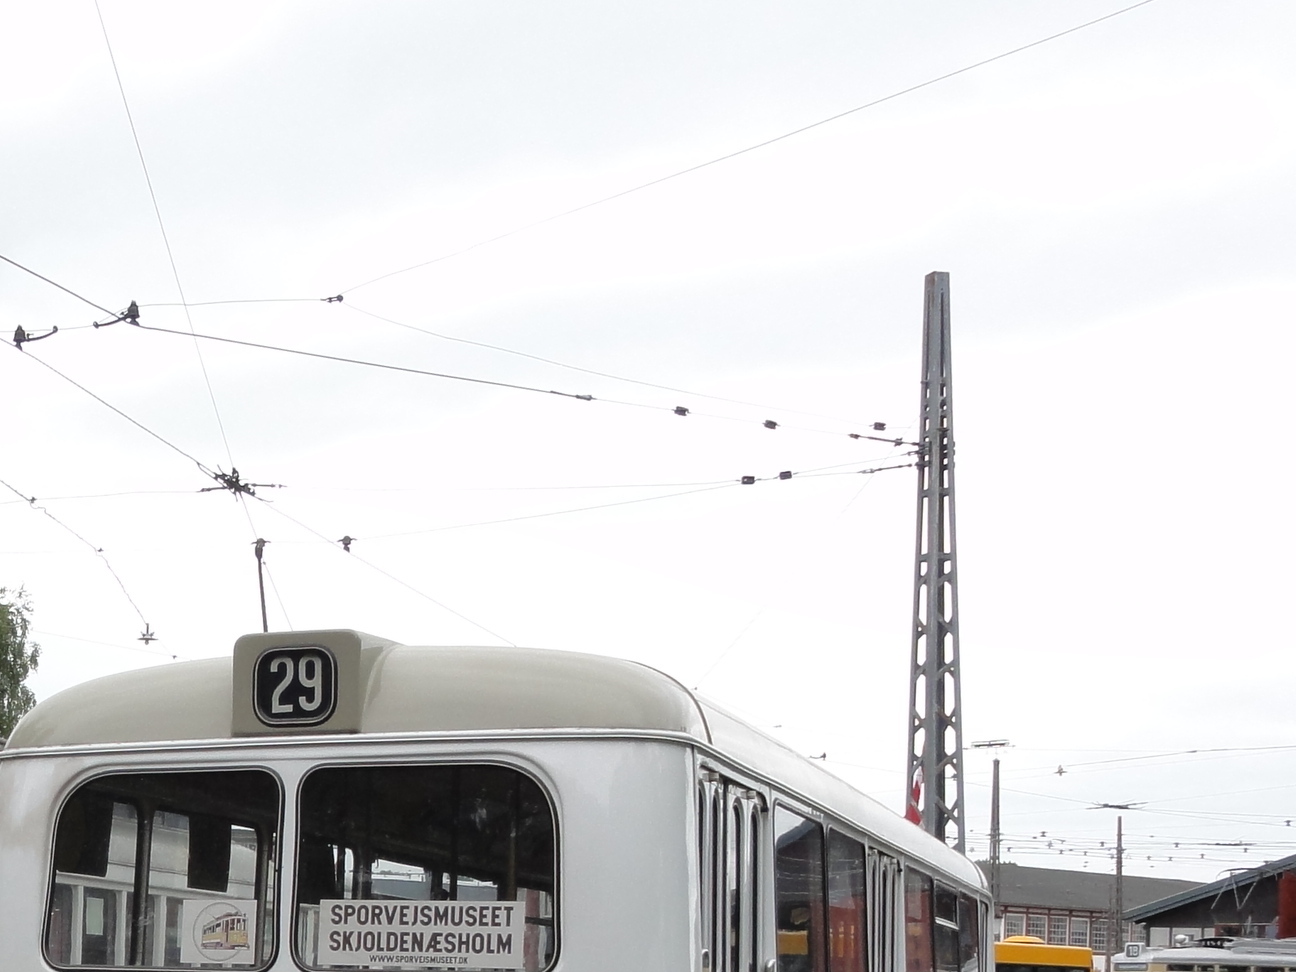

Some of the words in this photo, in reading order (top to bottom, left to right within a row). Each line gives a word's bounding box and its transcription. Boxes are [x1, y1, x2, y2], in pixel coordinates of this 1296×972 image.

[270, 655, 322, 714] 29
[330, 904, 514, 927] SPORVEJSMUSEET
[329, 930, 513, 954] SKJOLDENÆSHOLM
[369, 955, 468, 964] WWW.SPORVEJSMUSEET.DK
